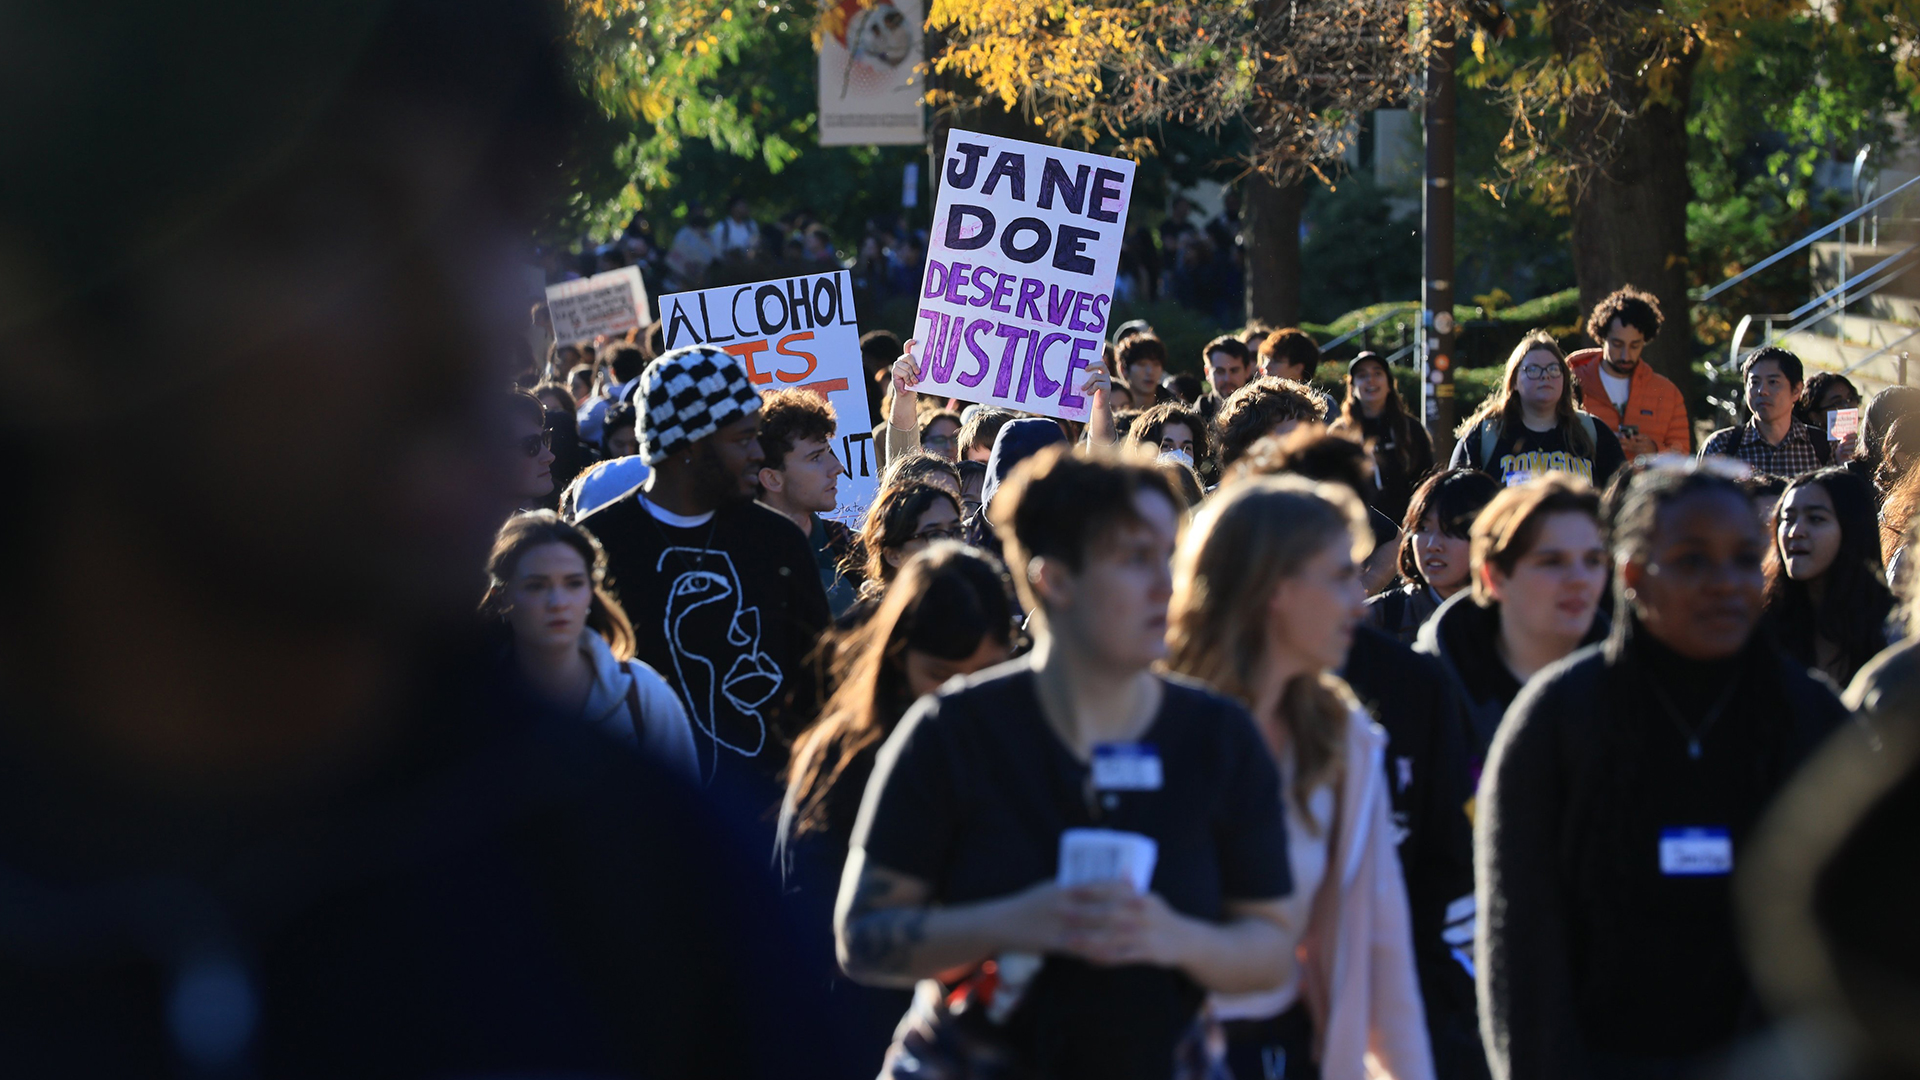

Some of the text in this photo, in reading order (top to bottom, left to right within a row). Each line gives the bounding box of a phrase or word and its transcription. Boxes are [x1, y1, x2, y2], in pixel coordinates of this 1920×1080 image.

[946, 142, 1125, 224] JANE
[944, 203, 1101, 276] DOE
[665, 272, 857, 349] ALCOHOL
[923, 259, 1110, 334] DESERVES
[722, 331, 818, 385] IS
[917, 308, 1098, 410] JUSTICE
[1500, 450, 1594, 487] TOWSON
